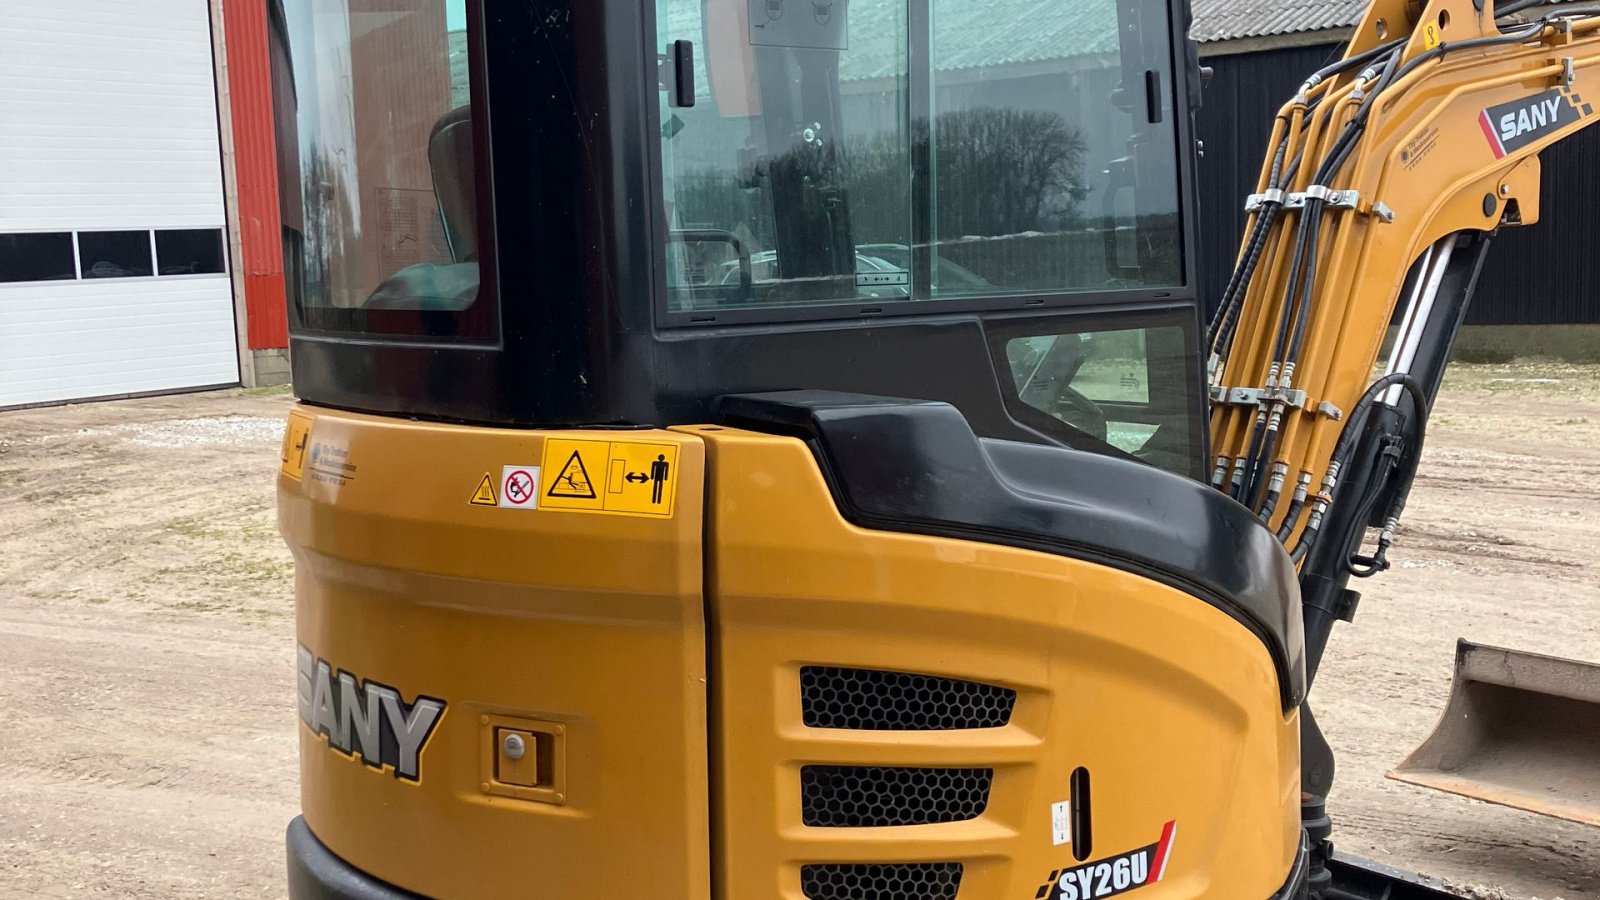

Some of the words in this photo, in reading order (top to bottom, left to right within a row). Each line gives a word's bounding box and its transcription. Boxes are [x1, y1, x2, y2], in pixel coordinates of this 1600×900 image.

[1500, 95, 1562, 142] SANY
[297, 641, 448, 784] SANY
[1058, 850, 1148, 899] SY26U
